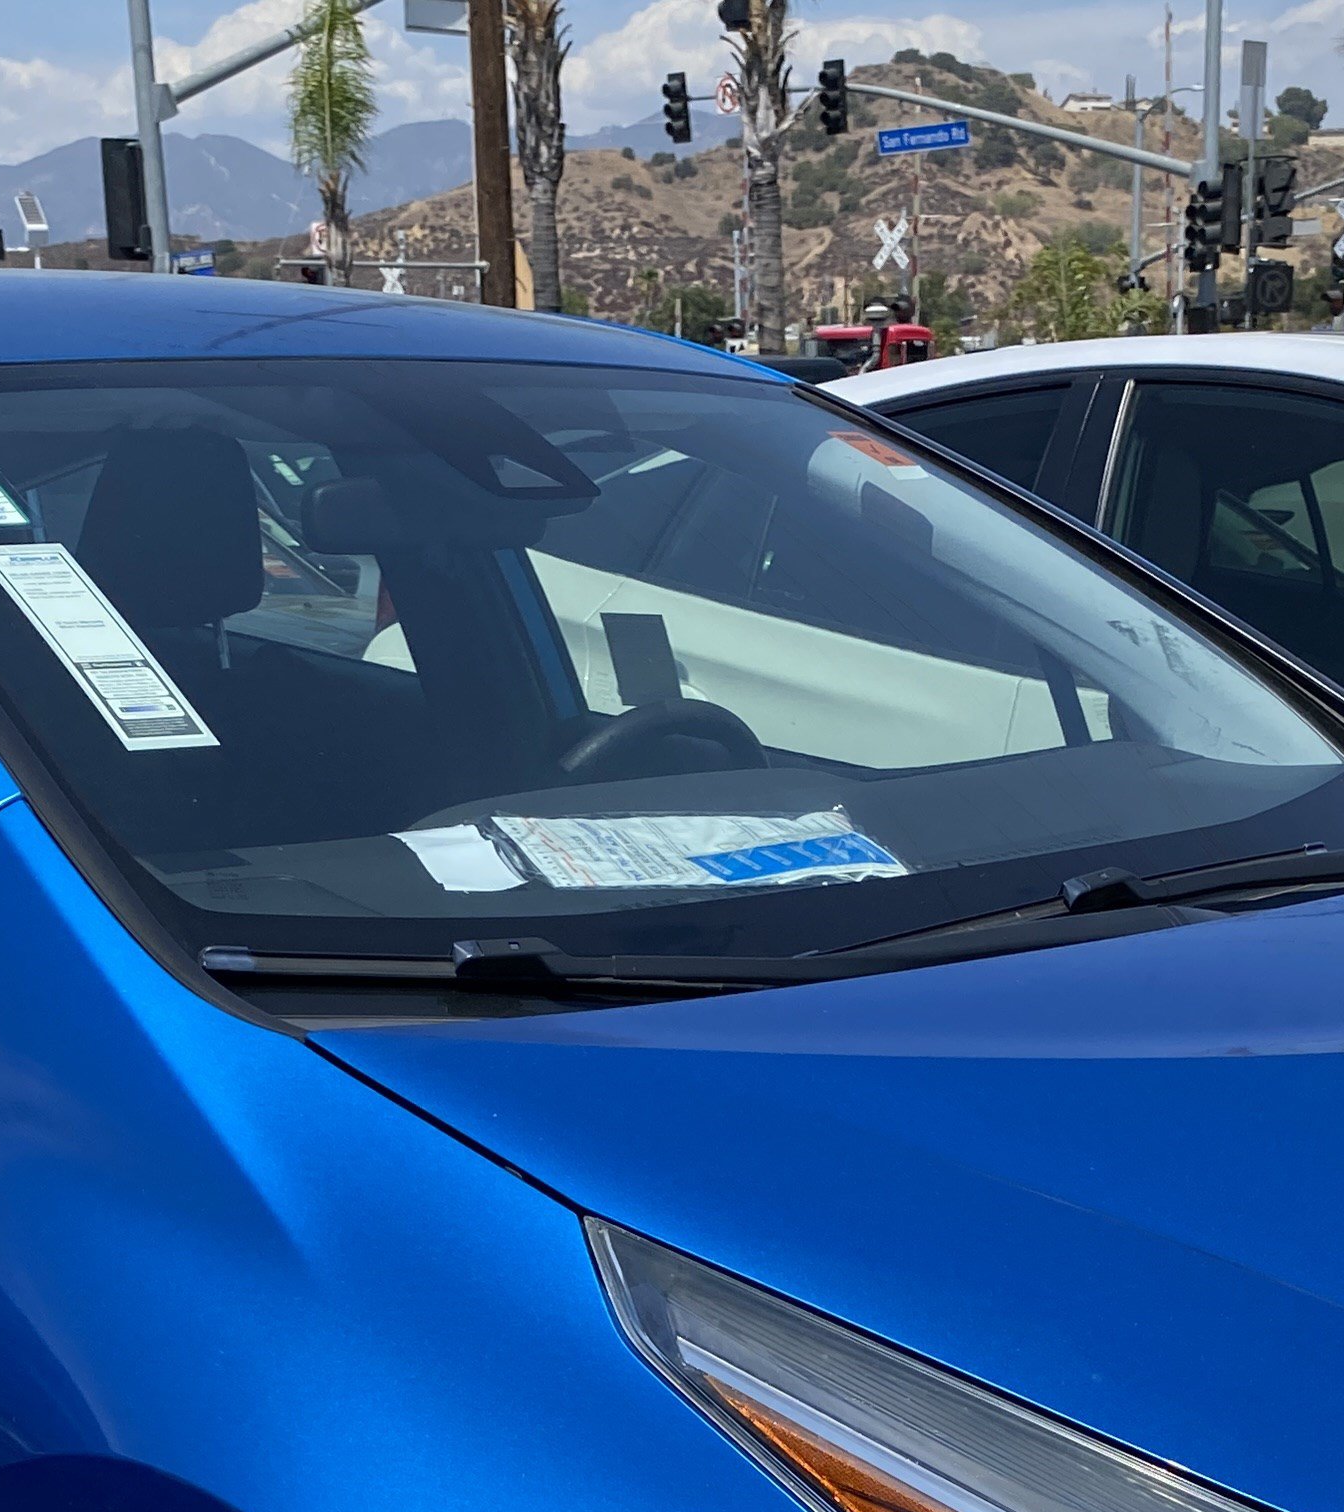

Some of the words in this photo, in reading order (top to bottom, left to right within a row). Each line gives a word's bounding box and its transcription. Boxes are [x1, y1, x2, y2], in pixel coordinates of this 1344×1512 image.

[881, 135, 902, 149] San
[903, 130, 950, 146] Fernando
[951, 126, 966, 140] Rd
